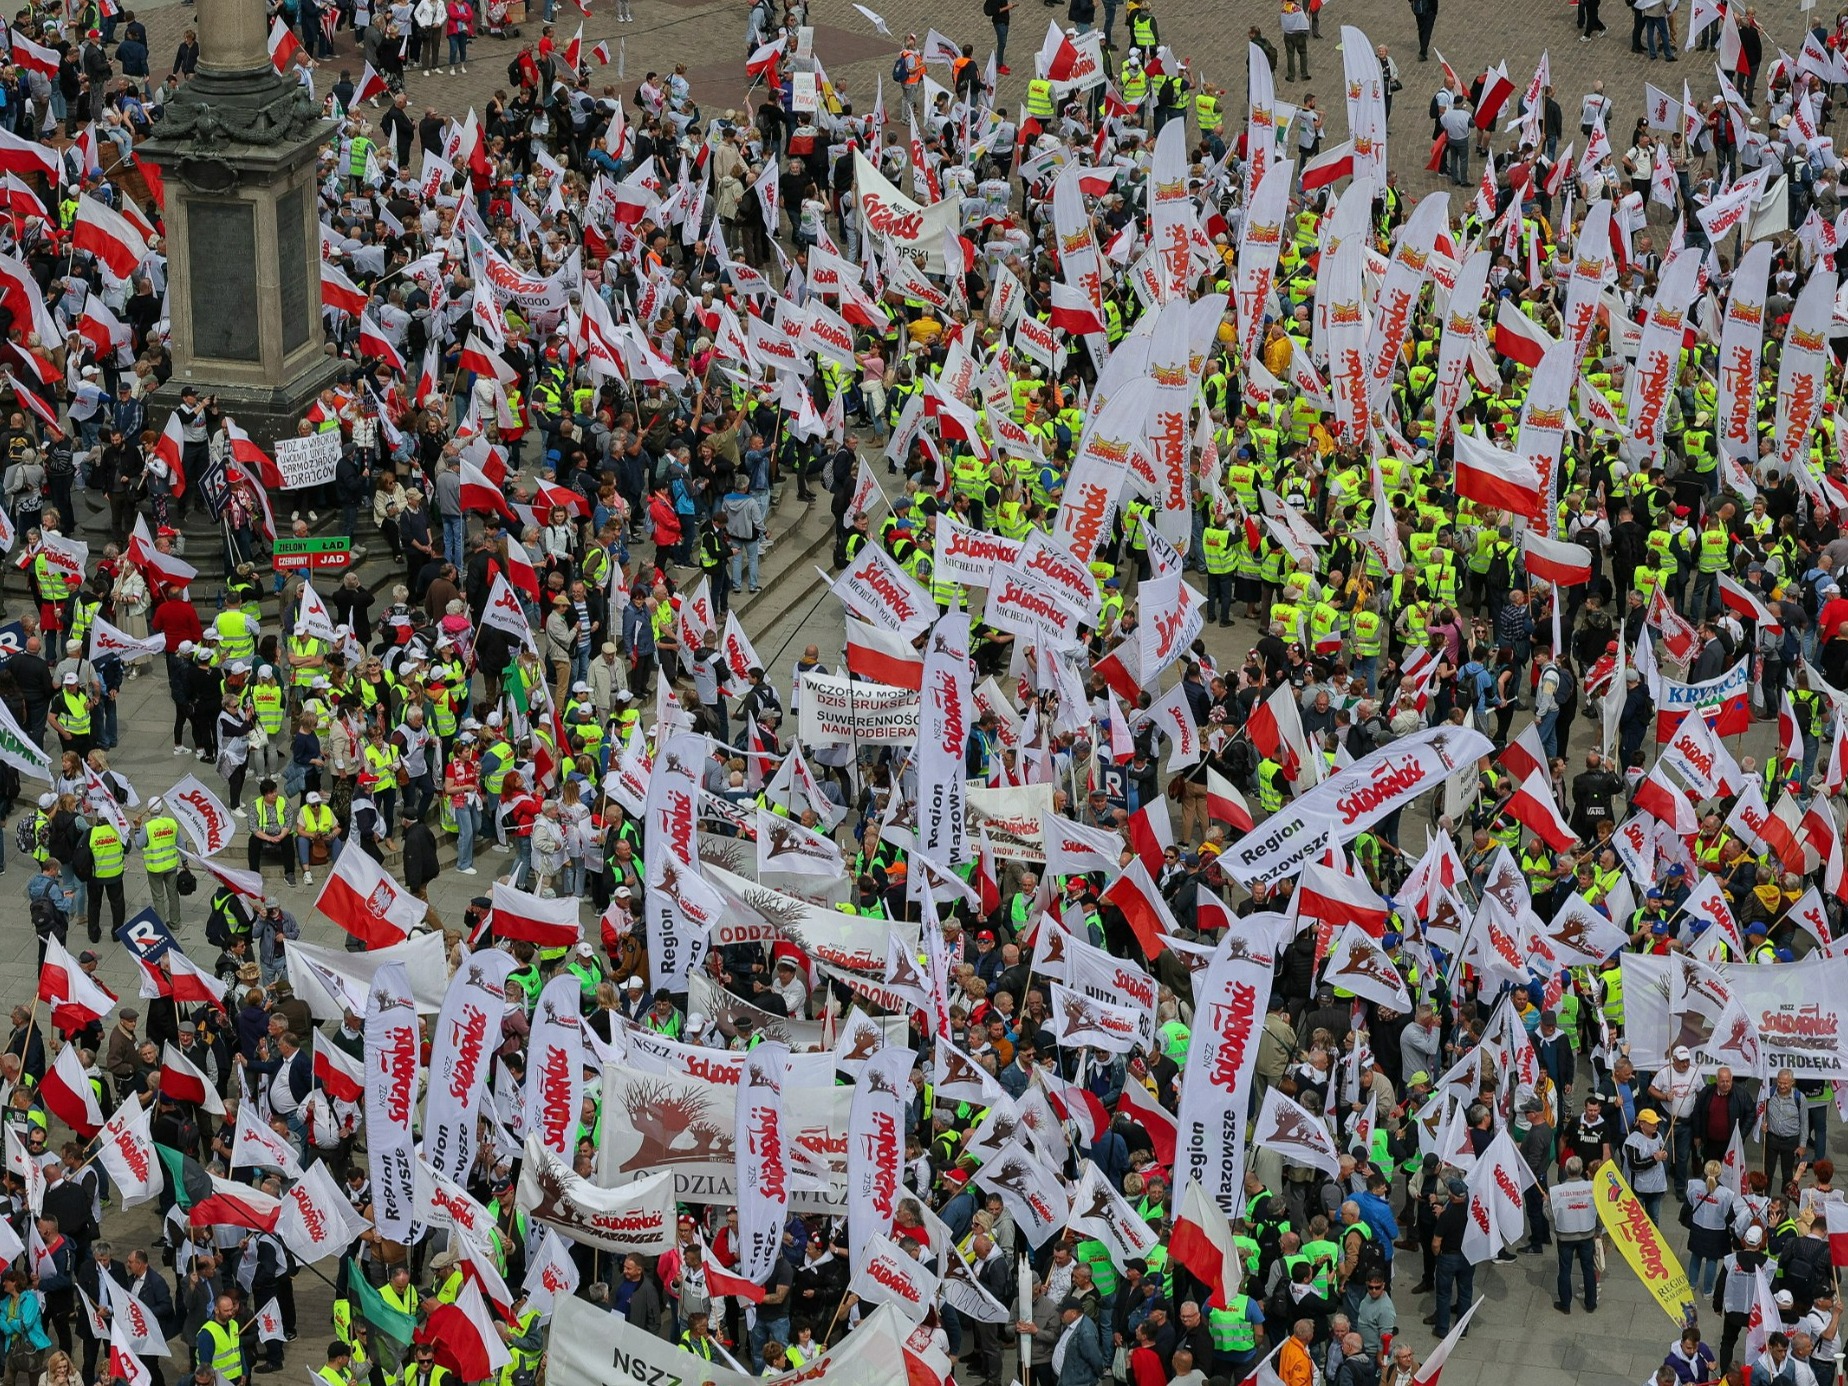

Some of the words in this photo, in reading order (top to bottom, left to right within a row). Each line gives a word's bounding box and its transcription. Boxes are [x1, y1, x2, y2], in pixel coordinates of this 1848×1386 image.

[284, 464, 335, 488] ZDRAJCÓW
[278, 542, 308, 553] ZIELONY
[322, 540, 345, 551] ŁAD
[278, 556, 308, 567] CZERWONY
[321, 554, 345, 565] JAD
[944, 556, 984, 575] MICHELIN
[878, 604, 902, 633] POLSKA
[995, 603, 1034, 626] MICHELIN
[806, 681, 872, 698] WCZORAJ
[817, 694, 847, 708] DZIŚ
[851, 695, 921, 710] BRUKSELA
[821, 723, 851, 736] NAM
[855, 727, 917, 738] ODBIERA
[1338, 778, 1360, 796] NSZZ
[1586, 806, 1605, 816] VANS
[971, 843, 1014, 857] CIANÓW
[1240, 817, 1306, 867] Region
[127, 920, 162, 951] R
[661, 908, 675, 975] Region
[719, 925, 790, 944] ODDZIA
[838, 975, 905, 1016] ARDOWIE
[632, 1036, 673, 1060] NSZZ
[1762, 1052, 1842, 1072] STROŁĘKA
[1216, 1109, 1237, 1214] Mazowsze
[385, 1155, 401, 1222] Region
